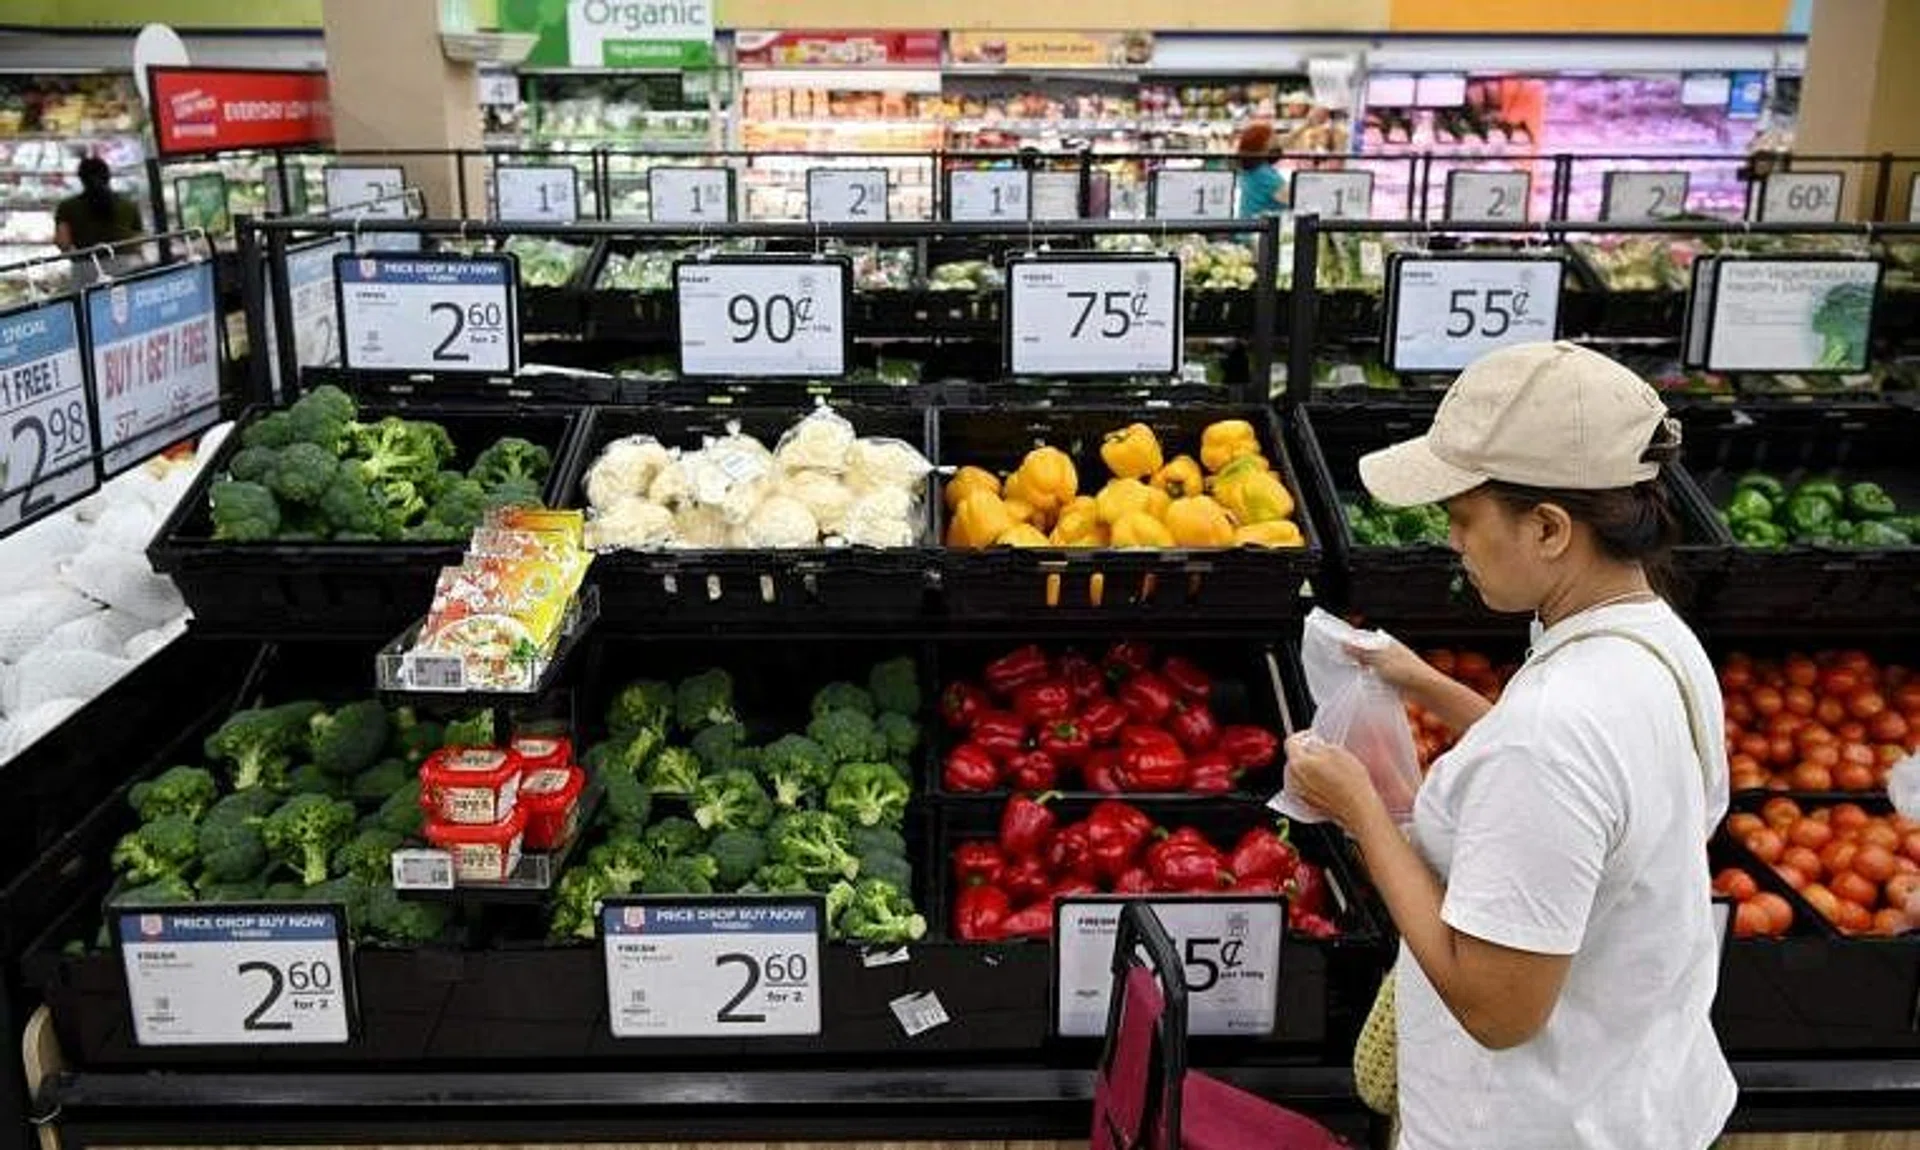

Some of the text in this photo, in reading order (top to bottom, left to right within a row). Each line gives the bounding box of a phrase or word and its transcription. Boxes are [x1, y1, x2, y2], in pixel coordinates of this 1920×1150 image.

[584, 0, 706, 30] Organic
[467, 303, 501, 327] 60
[430, 302, 470, 361] 2
[48, 401, 86, 453] 98
[12, 414, 56, 519] 2
[173, 916, 327, 929] PRICE DROP BUY NOW
[656, 910, 807, 921] PRICE DROP BUY NOW
[288, 961, 332, 990] 60
[764, 954, 808, 982] 60
[238, 961, 293, 1030] 2
[715, 953, 767, 1023] 2
